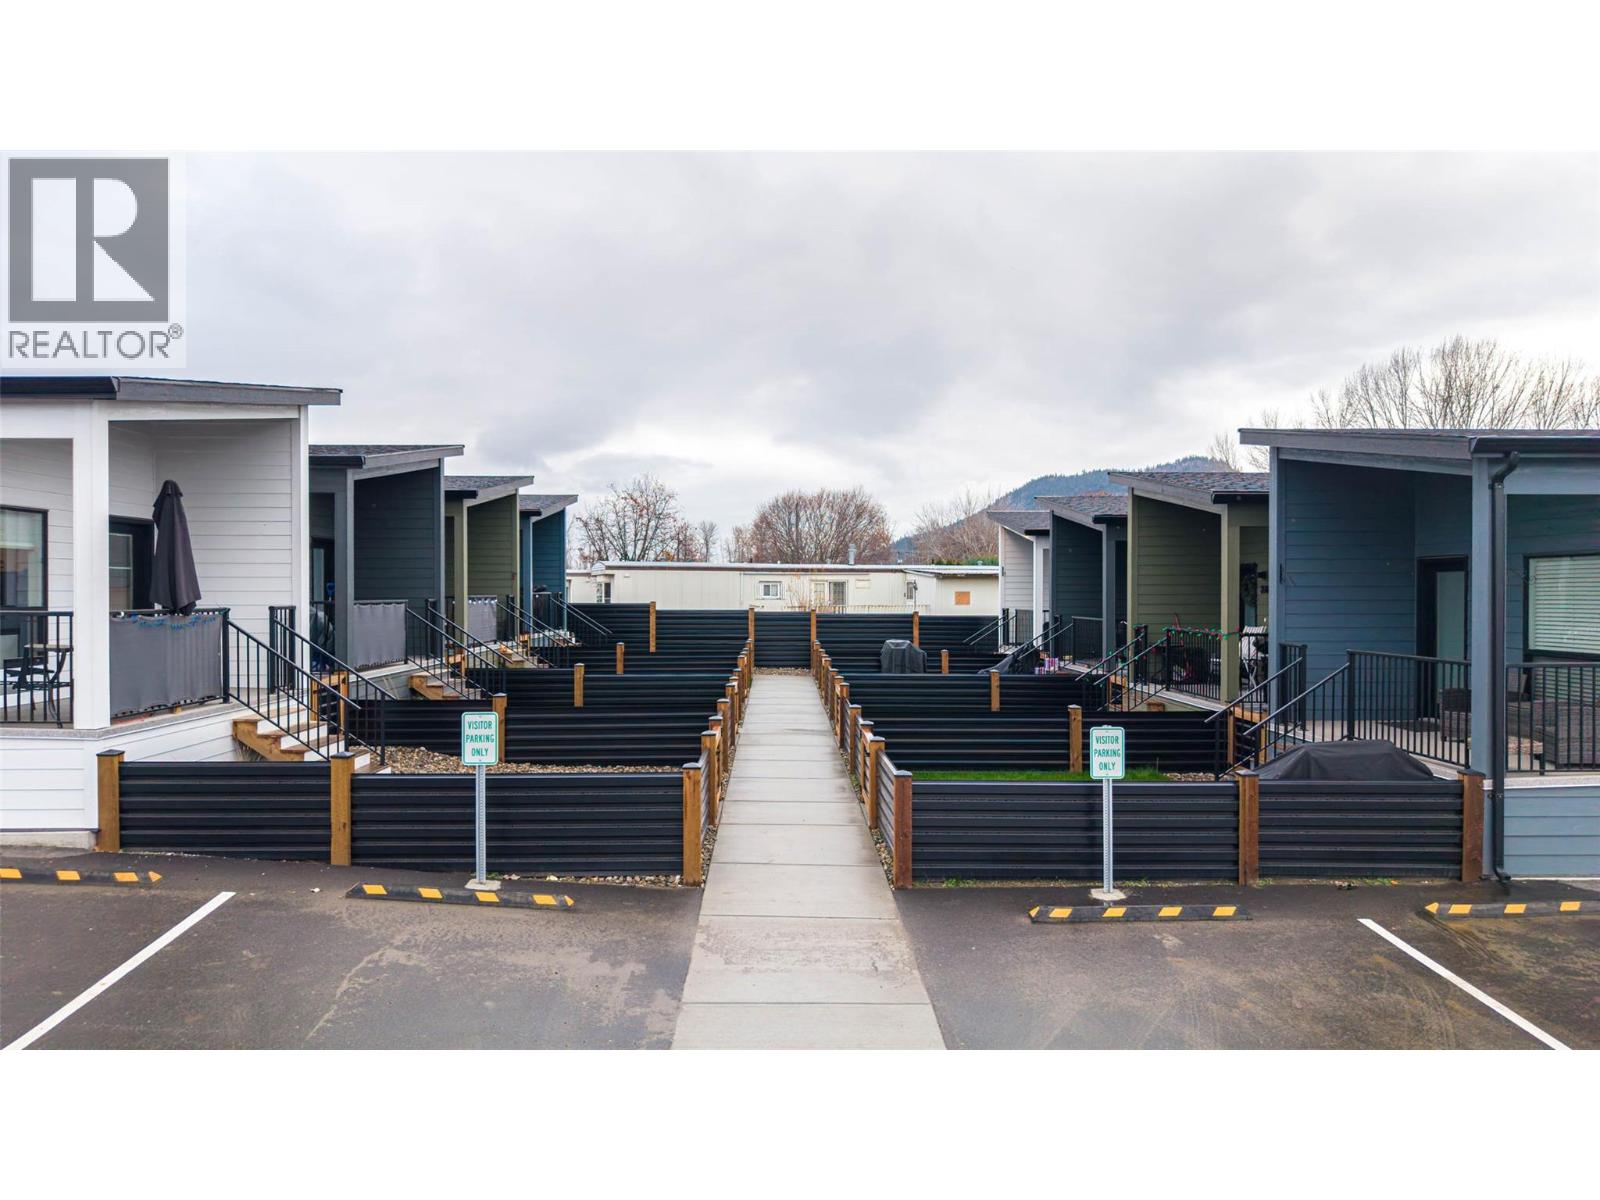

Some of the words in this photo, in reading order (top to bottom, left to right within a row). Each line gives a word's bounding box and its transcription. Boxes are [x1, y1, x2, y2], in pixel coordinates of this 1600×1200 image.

[467, 721, 493, 729] VISITOR
[465, 734, 495, 743] PARKING
[1095, 736, 1119, 744] VISITOR
[471, 748, 489, 756] ONLY
[1093, 749, 1121, 757] PARKING
[1098, 762, 1116, 770] ONLY
